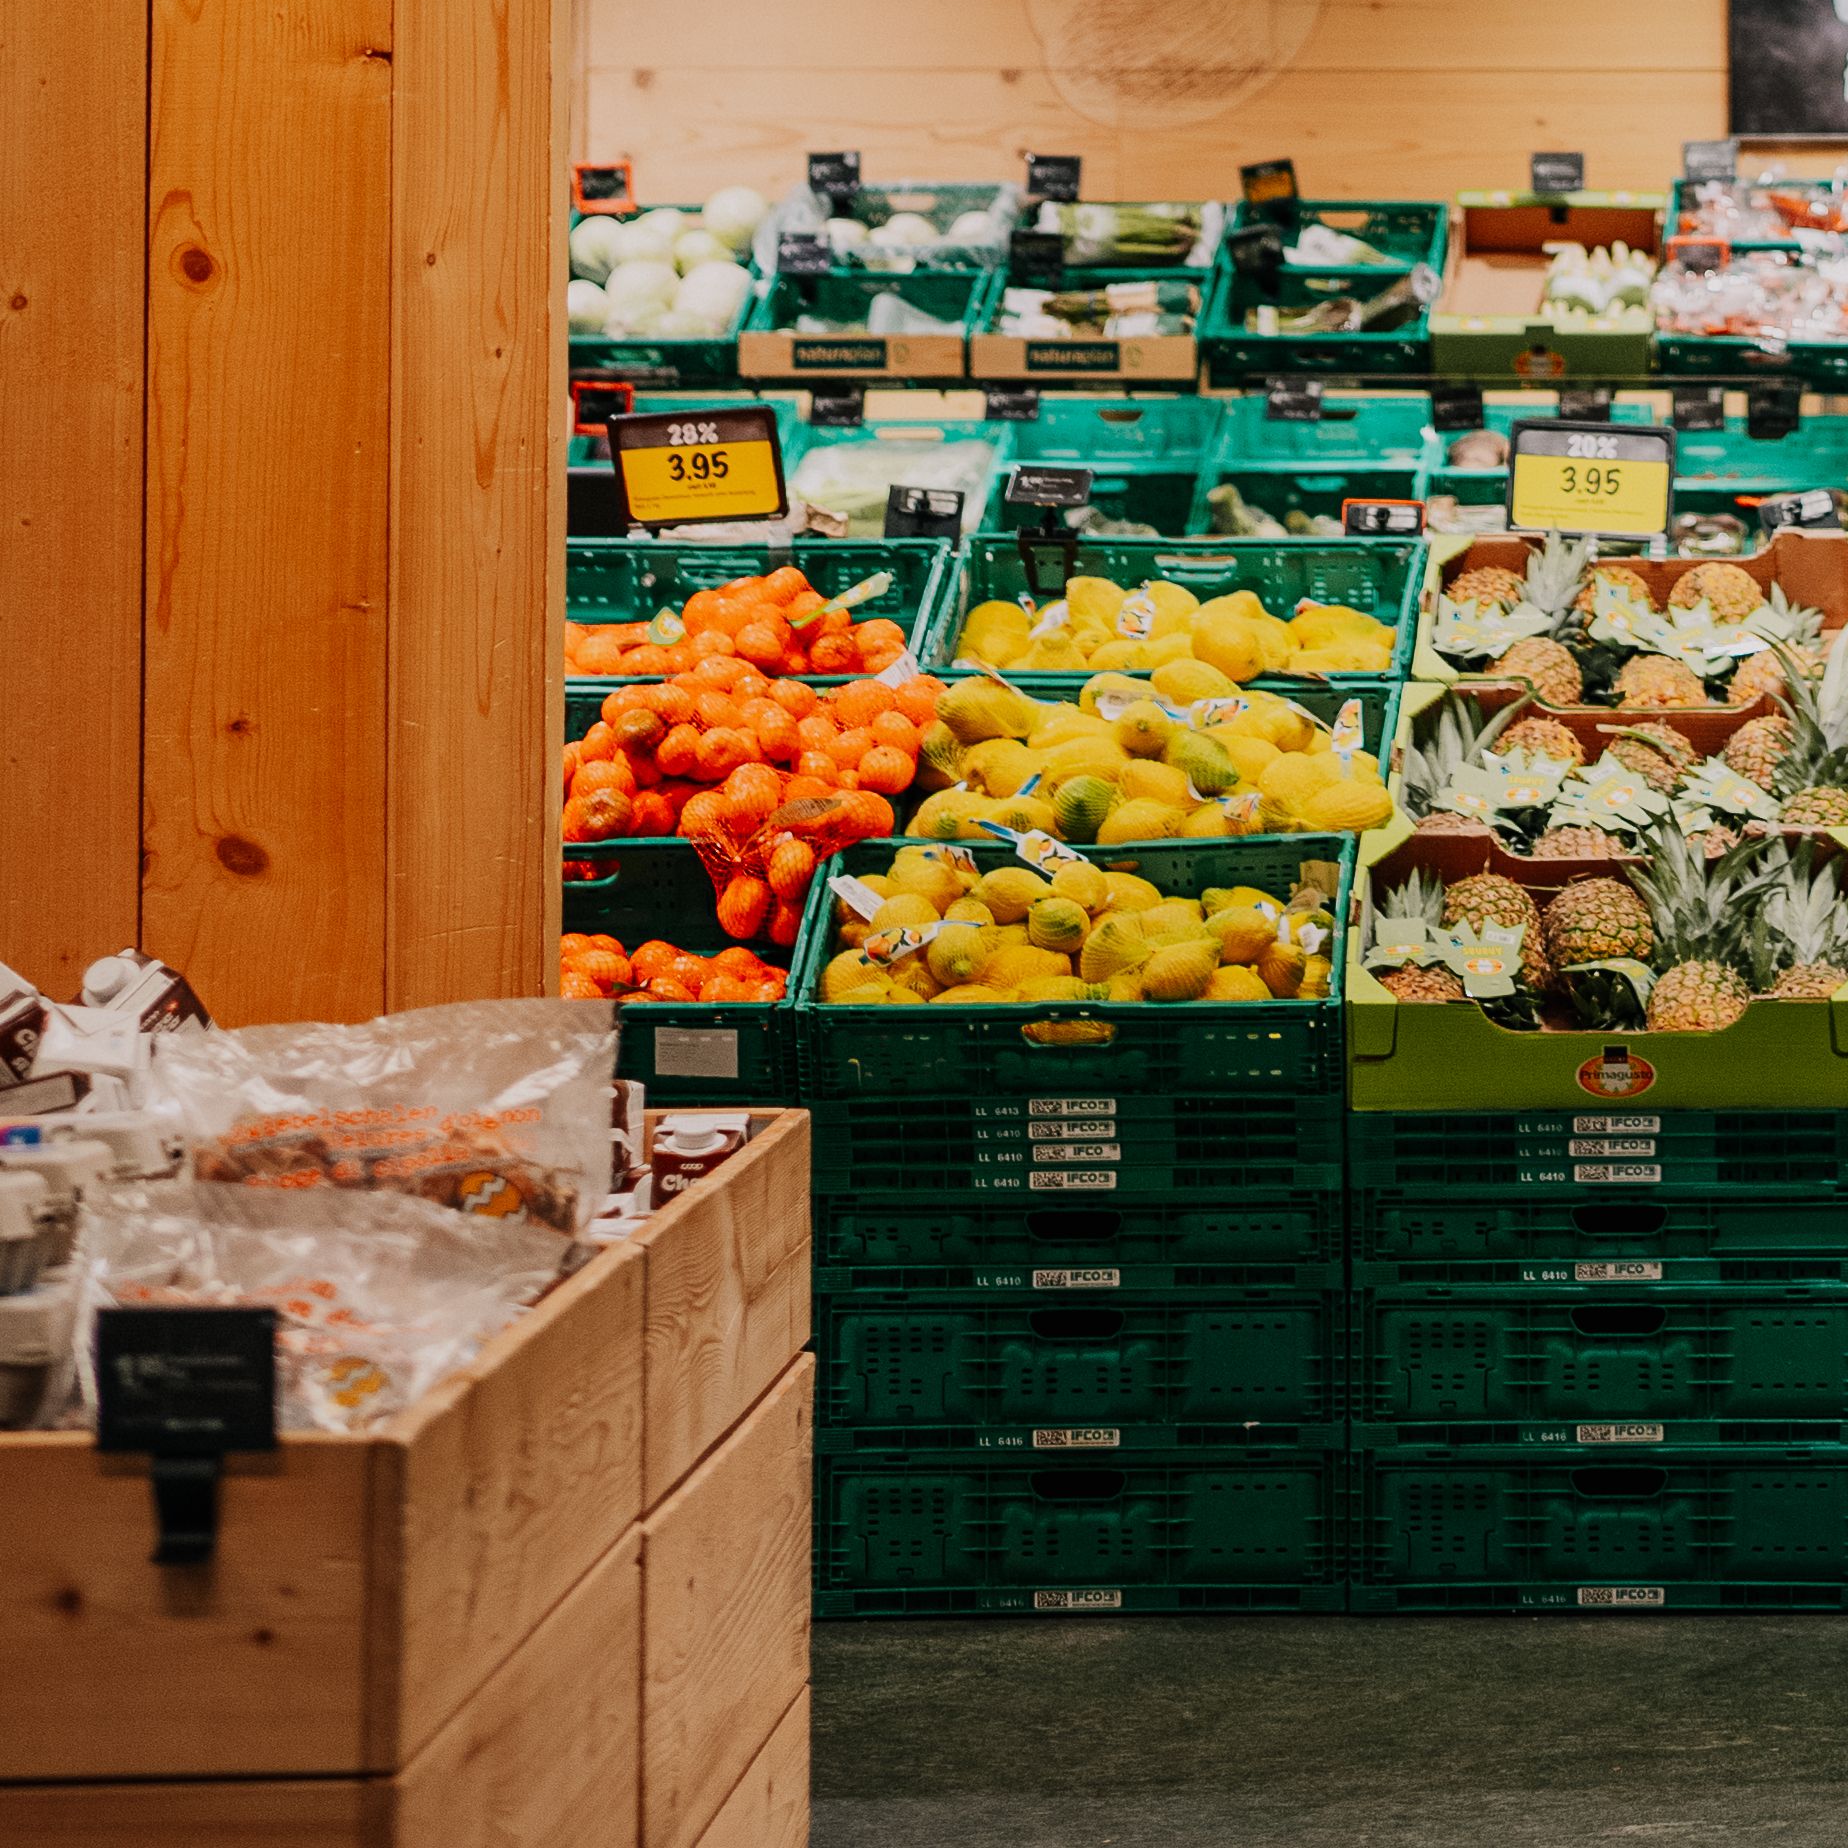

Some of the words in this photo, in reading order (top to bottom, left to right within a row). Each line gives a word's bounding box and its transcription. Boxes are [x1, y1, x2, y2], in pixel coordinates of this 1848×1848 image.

[667, 422, 719, 445] 28%
[1567, 434, 1619, 459] 20%
[667, 451, 729, 481] 3.95
[1561, 466, 1621, 495] 3.95
[1580, 1070, 1654, 1081] Primagusto
[1066, 1101, 1097, 1110] IFCO
[975, 1107, 987, 1116] LL
[1067, 1122, 1098, 1132] IFCO
[1611, 1117, 1641, 1127] IFCO
[1518, 1123, 1531, 1133] LL
[977, 1130, 989, 1139] LL
[1608, 1140, 1639, 1150] IFCO
[1072, 1146, 1103, 1155] IFCO
[978, 1153, 991, 1162] LL
[997, 1153, 1023, 1162] 6410
[1612, 1166, 1643, 1176] IFCO
[1067, 1173, 1097, 1183] IFCO
[1520, 1172, 1533, 1182] LL
[1539, 1172, 1566, 1182] 6410
[975, 1178, 987, 1188] LL
[1614, 1264, 1644, 1274] IFCO
[1070, 1271, 1101, 1281] IFCO
[1523, 1271, 1536, 1281] LL
[1541, 1270, 1568, 1281] 6410
[976, 1276, 989, 1286] LL
[995, 1276, 1021, 1286] 6410
[1071, 1430, 1102, 1441] IFCO
[1614, 1425, 1645, 1436] IFCO
[979, 1436, 991, 1447] LL
[1072, 1591, 1103, 1602] IFCO
[1616, 1589, 1647, 1599] IFCO
